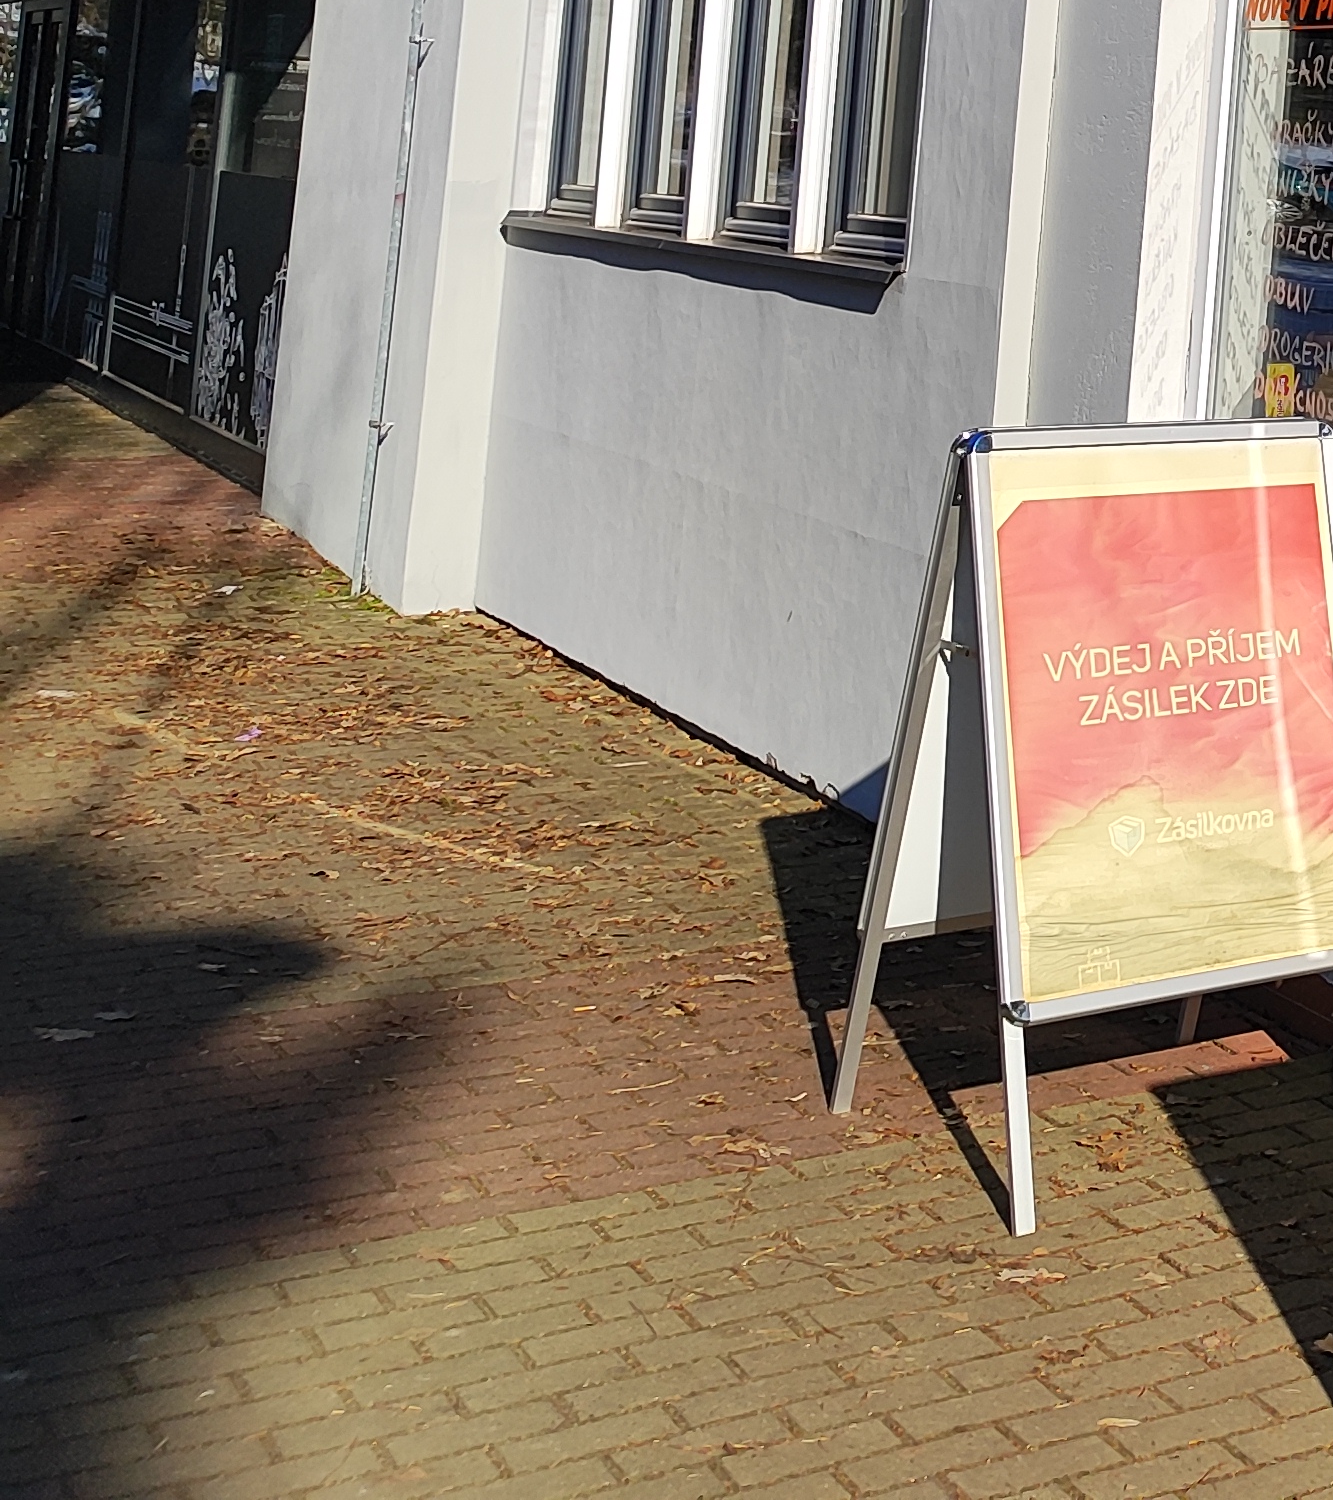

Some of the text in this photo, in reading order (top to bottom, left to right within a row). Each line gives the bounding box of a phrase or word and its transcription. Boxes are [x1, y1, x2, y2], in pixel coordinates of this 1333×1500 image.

[1043, 628, 1301, 682] VÝDEJ A PŘÍJEM
[1078, 674, 1280, 726] ZÁSILEK ZDE
[1154, 808, 1274, 843] Zásilkovna
